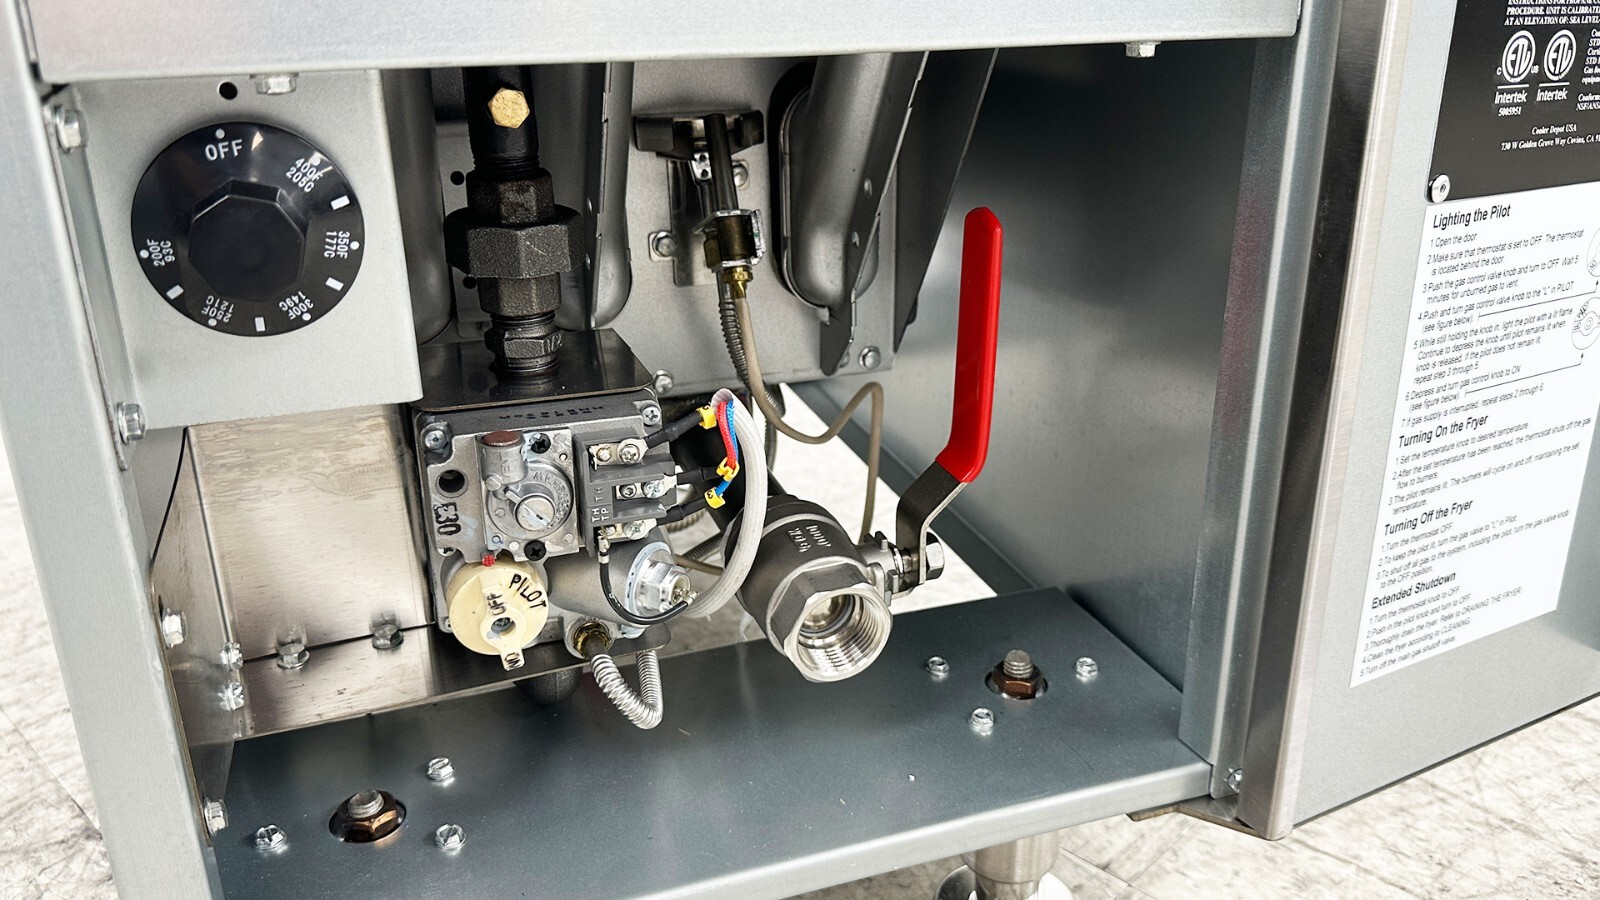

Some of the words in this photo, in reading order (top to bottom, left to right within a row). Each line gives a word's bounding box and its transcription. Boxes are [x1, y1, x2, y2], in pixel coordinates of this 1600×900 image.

[1504, 17, 1514, 25] AT
[1514, 17, 1524, 25] AN
[1524, 16, 1558, 25] ELEVATION
[1569, 16, 1580, 24] SEA
[1545, 6, 1560, 14] UNIT
[1561, 6, 1567, 14] IS
[1494, 90, 1528, 104] Intertek
[1536, 88, 1568, 102] Intertek
[1531, 127, 1549, 136] Cooler
[1549, 125, 1565, 135] Depot
[1566, 124, 1577, 132] USA
[205, 138, 243, 161] OFF
[1518, 141, 1538, 149] Golden
[1538, 139, 1554, 148] Grove
[1554, 138, 1566, 147] Way
[1586, 135, 1594, 143] CA
[286, 167, 315, 193] 205C
[295, 157, 323, 182] 400F
[1433, 211, 1471, 230] Lighting
[1473, 208, 1487, 221] the
[1490, 204, 1510, 218] Pilot
[147, 239, 164, 267] 200F
[160, 240, 175, 263] 93C
[324, 231, 337, 258] 177C
[337, 230, 350, 259] 350F
[206, 295, 234, 311] 121C
[279, 291, 305, 311] 149C
[289, 301, 314, 321] 300F
[201, 305, 232, 323] 250F
[1399, 430, 1432, 447] Turning
[1435, 425, 1447, 437] On
[1450, 421, 1463, 433] the
[1465, 415, 1488, 430] Fryer
[433, 502, 461, 537] E30
[591, 508, 600, 522] TH
[601, 508, 609, 522] TP
[1384, 518, 1417, 535] Turning
[1420, 509, 1434, 524] Off
[1435, 507, 1448, 519] the
[1450, 500, 1472, 514] Fryer
[509, 573, 547, 609] PILOT
[1371, 585, 1412, 608] Extended
[1414, 572, 1455, 593] Shutdown
[487, 592, 506, 616] OFF
[504, 651, 522, 668] ON
